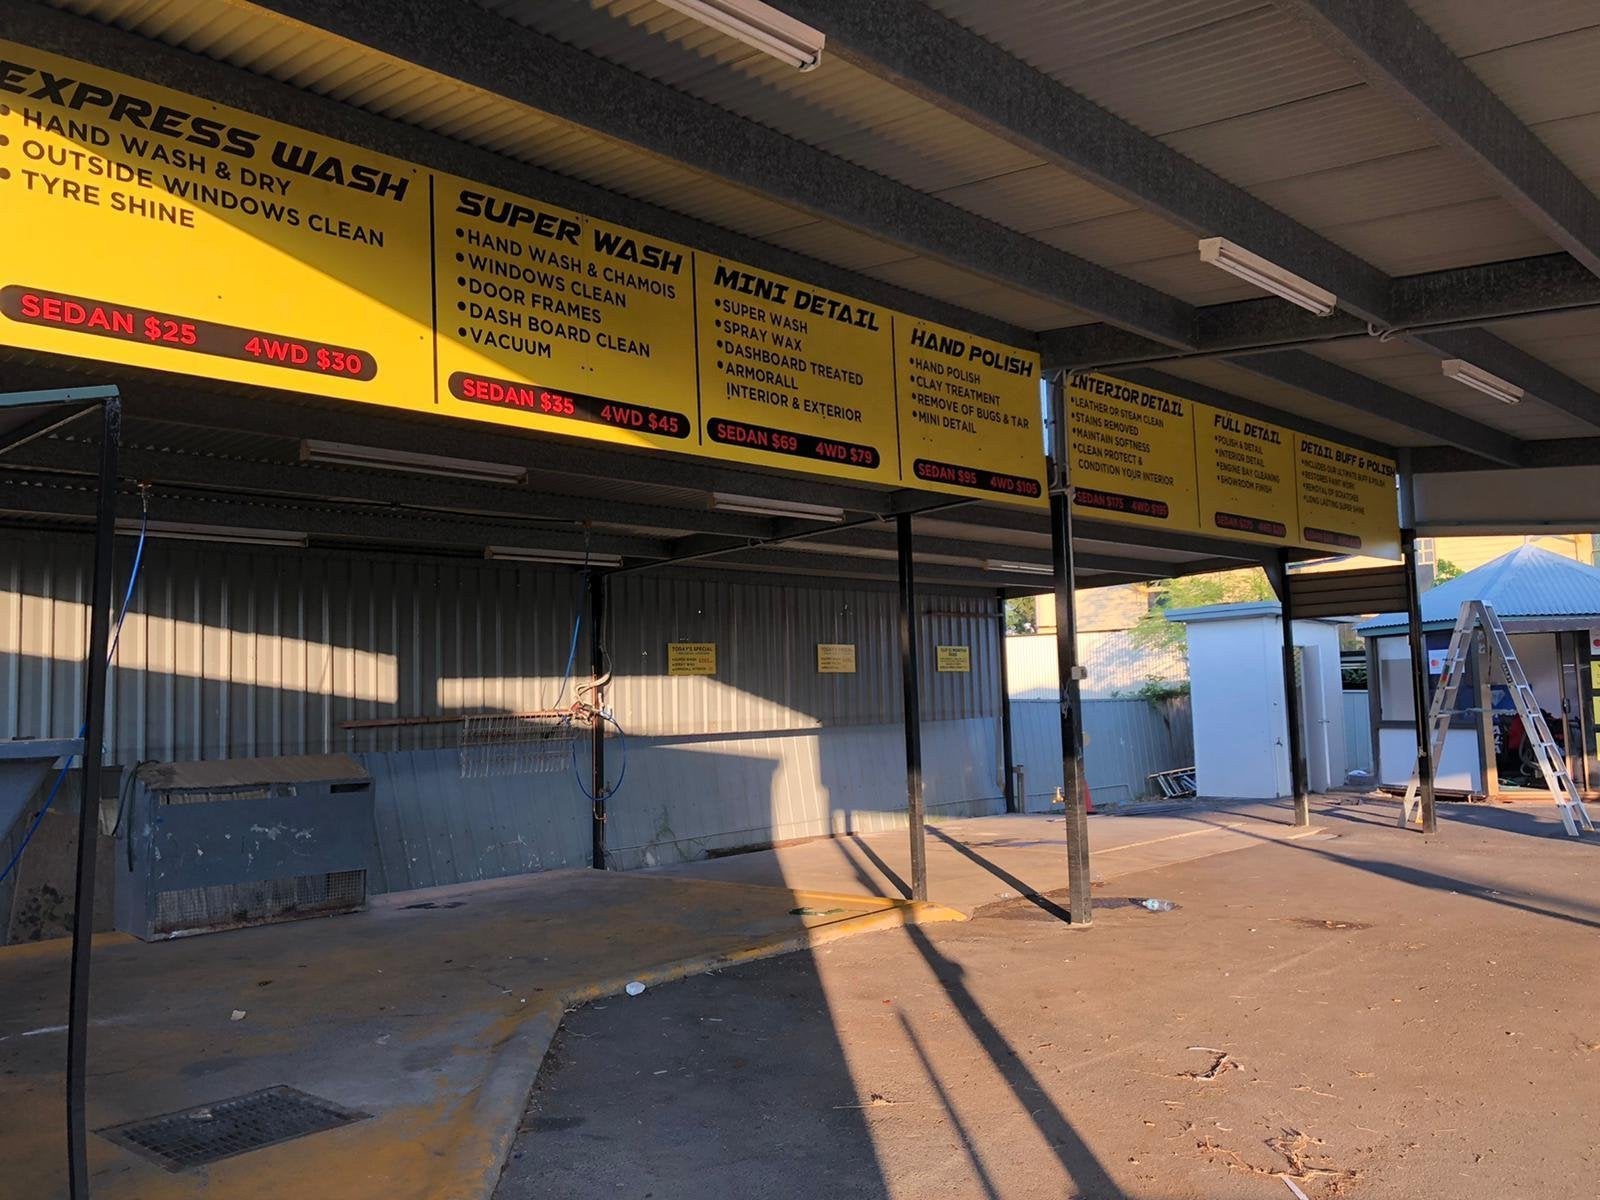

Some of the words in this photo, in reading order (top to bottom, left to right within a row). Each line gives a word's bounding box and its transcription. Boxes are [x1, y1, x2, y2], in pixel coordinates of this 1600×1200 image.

[0, 61, 260, 158] EXPRESS
[272, 141, 409, 201] WASH
[23, 107, 110, 146] HAND
[120, 134, 206, 174] WASH
[215, 162, 231, 180] &
[240, 168, 291, 196] DRY
[22, 139, 153, 189] OUTSIDE
[162, 174, 300, 226] WINDOWS
[308, 214, 384, 247] CLEAN
[22, 169, 100, 206] TYRE
[110, 192, 195, 229] SHINE
[456, 190, 582, 245] SUPER
[594, 229, 683, 274] WASH
[468, 229, 522, 256] HAND
[528, 245, 581, 272] WASH
[588, 263, 598, 277] &
[603, 267, 676, 299] CHAMOIS
[468, 253, 565, 292] WINDOWS
[571, 281, 626, 307] CLEAN
[470, 278, 525, 305] DOOR
[532, 293, 602, 323] FRAMES
[714, 266, 789, 305] MINI
[794, 289, 880, 332] DETAIL
[723, 300, 766, 323] SUPER
[770, 312, 808, 334] WASH
[21, 293, 134, 335] SEDAN
[144, 315, 197, 346] $25
[244, 336, 309, 365] 4WD
[316, 347, 362, 375] $30
[470, 302, 521, 328] DASH
[529, 316, 590, 343] BOARD
[596, 333, 650, 358] CLEAN
[470, 327, 551, 358] VACUUM
[724, 321, 767, 343] SPRAY
[772, 332, 802, 352] WAX
[725, 341, 807, 372] DASHBOARD
[810, 362, 863, 386] TREATED
[911, 328, 966, 358] HAND
[969, 345, 1033, 377] POLISH
[915, 358, 944, 375] HAND
[947, 366, 981, 385] POLISH
[725, 362, 799, 390] ARMORALL
[917, 375, 943, 390] CLAY
[945, 383, 1000, 406] TREATMENT
[1070, 374, 1139, 405] INTERIOR
[1141, 393, 1184, 417] DETAIL
[463, 378, 534, 407] SEDAN
[540, 392, 575, 415] $35
[600, 404, 643, 427] 4WD
[649, 412, 678, 433] $45
[727, 383, 788, 408] INTERIOR
[792, 397, 800, 410] &
[804, 399, 862, 423] EXTERIOR
[917, 393, 958, 413] REMOVE
[961, 404, 974, 416] OF
[977, 408, 1001, 423] BUGS
[1003, 415, 1009, 425] &
[1012, 416, 1029, 429] TAR
[919, 411, 940, 425] MINI
[943, 416, 977, 434] DETAIL
[1075, 398, 1107, 413] LEATHER
[1109, 406, 1119, 416] OR
[1120, 410, 1142, 423] STEAM
[1143, 415, 1164, 428] CLEAN
[717, 423, 768, 447] SEDAN
[772, 433, 798, 450] $69
[815, 441, 847, 460] 4WD
[850, 448, 873, 464] $79
[1076, 413, 1102, 427] STAINS
[1104, 419, 1139, 436] REMOVED
[1077, 428, 1113, 445] MAINTAIN
[1115, 437, 1150, 453] SOFTNESS
[1214, 414, 1241, 433] FULL
[1243, 423, 1282, 444] DETAIL
[1077, 444, 1103, 457] CLEAN
[1104, 449, 1136, 465] PROTECT
[1078, 459, 1121, 475] CONDITION
[1122, 467, 1142, 480] YOUR
[1143, 473, 1174, 486] INTERIOR
[1301, 440, 1333, 459] DETAIL
[1335, 451, 1358, 466] BUFF
[1358, 457, 1364, 468] &
[1366, 460, 1396, 478] POLISH
[918, 463, 955, 482] SEDAN
[958, 471, 977, 484] $95
[990, 476, 1014, 490] 4WD
